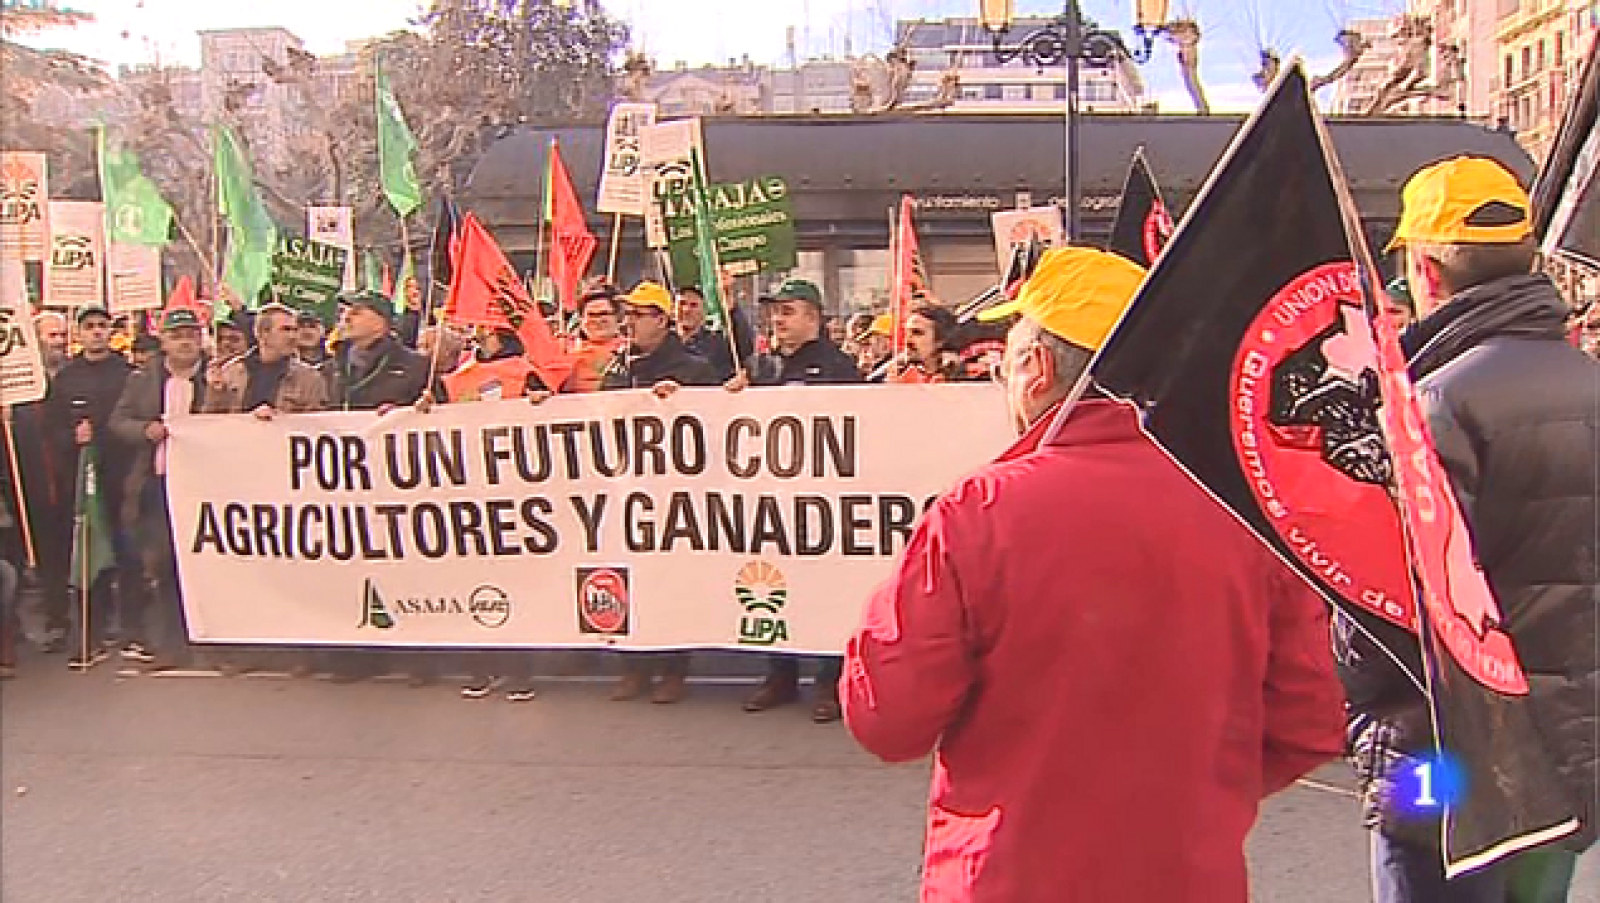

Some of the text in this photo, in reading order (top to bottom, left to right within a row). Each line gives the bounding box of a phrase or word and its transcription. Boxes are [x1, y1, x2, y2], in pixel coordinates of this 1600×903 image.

[289, 414, 856, 491] POR UN FUTURO CON
[191, 496, 560, 561] AGRICULTORES
[571, 493, 608, 553] Y
[395, 596, 465, 615] ASAJA
[738, 617, 789, 645] UPA
